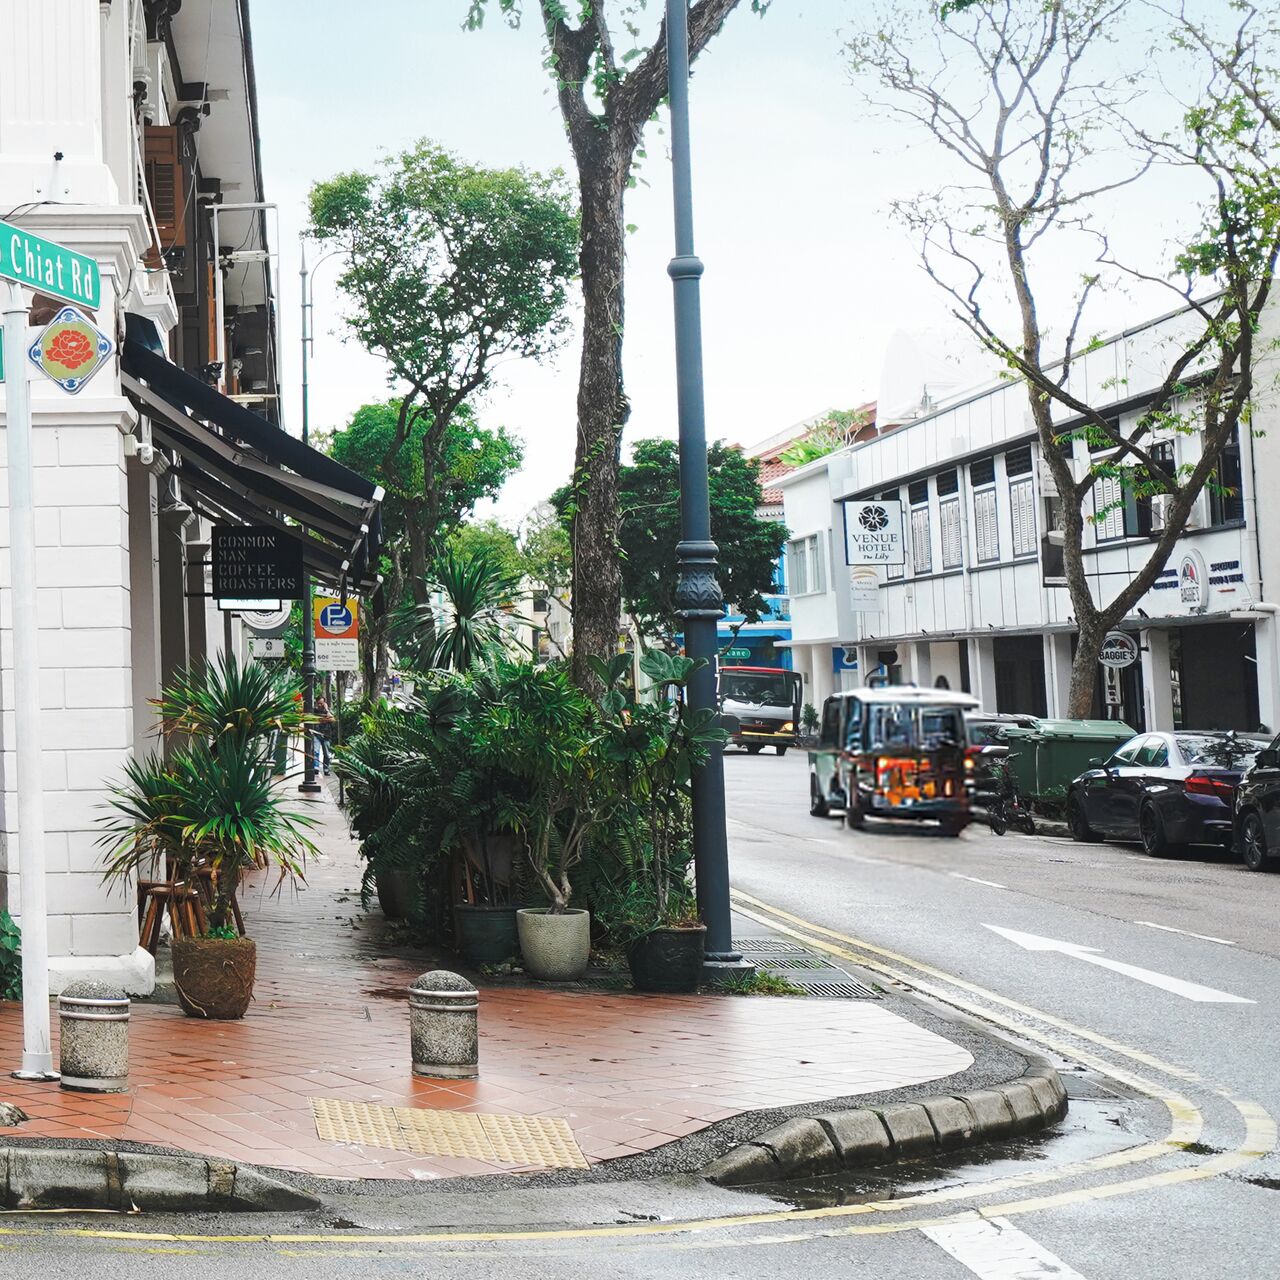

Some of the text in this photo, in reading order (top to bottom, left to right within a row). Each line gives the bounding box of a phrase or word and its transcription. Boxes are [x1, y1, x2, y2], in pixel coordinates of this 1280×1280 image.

[10, 233, 64, 291] Chiat
[70, 257, 93, 301] Rd
[218, 536, 276, 548] COMMON
[852, 533, 898, 543] VENUE
[858, 544, 894, 552] HOTEL
[219, 550, 246, 561] MAN
[874, 553, 889, 561] Lily
[218, 564, 276, 576] COFFEE
[219, 578, 296, 590] ROASTERS
[1099, 651, 1135, 660] BAGGIE'S
